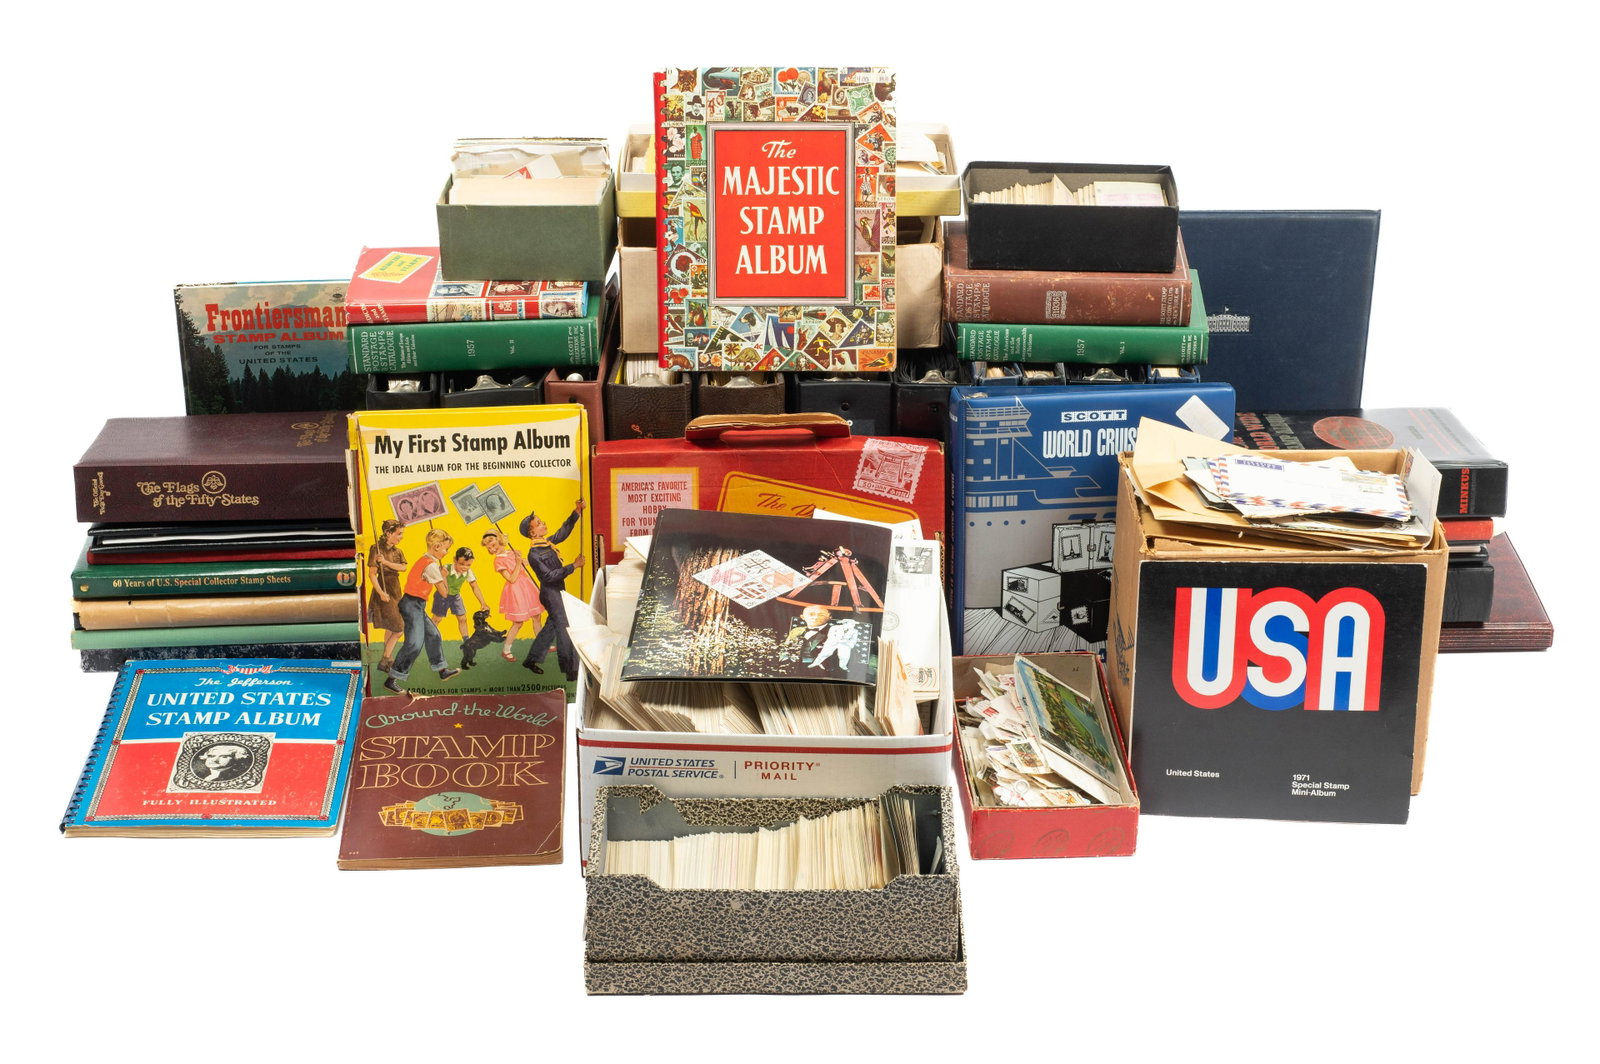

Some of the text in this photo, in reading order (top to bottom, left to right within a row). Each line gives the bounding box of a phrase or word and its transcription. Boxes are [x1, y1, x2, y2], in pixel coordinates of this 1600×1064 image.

[761, 140, 796, 160] The
[723, 166, 839, 196] MAJESTIC
[740, 206, 824, 235] STAMP
[736, 245, 828, 274] ALBUM
[1052, 297, 1060, 314] 1936
[205, 302, 348, 332] Frontiersman
[212, 332, 344, 343] STAMP ALBUM
[361, 332, 372, 372] STANDARD
[370, 331, 380, 371] POSTAGE
[386, 330, 397, 370] CATALOGUE
[466, 340, 476, 357] 1957
[1064, 410, 1126, 422] SCOTT
[375, 428, 570, 458] My First Stamp Album
[1043, 428, 1139, 458] WORLD CRUIS
[375, 459, 571, 474] THE IDEAL ALBUM FOR THE BEGINNING COLLECTOR
[137, 481, 199, 495] The Flags
[621, 481, 687, 491] AMERICA'S FAVORITE
[1460, 468, 1470, 515] MINKUS
[153, 494, 259, 507] of the Fifty States
[628, 493, 681, 502] MOST EXCITING
[757, 493, 786, 510] The
[622, 518, 635, 526] FOR
[113, 575, 291, 588] 60 Years of U.S. Special Collector Stamp Sheets
[1172, 587, 1386, 711] USA
[195, 677, 293, 687] The Jefferson
[146, 692, 332, 706] UNITED STATES
[146, 712, 322, 726] STAMP ALBUM
[365, 703, 558, 729] Around-the-World
[360, 734, 556, 762] STAMP
[631, 758, 715, 768] UNITED STATES
[744, 761, 814, 770] PRIORITY
[356, 761, 549, 790] BOOK
[628, 769, 717, 778] POSTAL SERVICE
[1166, 769, 1220, 778] United States
[1292, 781, 1350, 790] Special Stamp
[1292, 789, 1336, 797] Mini-Album
